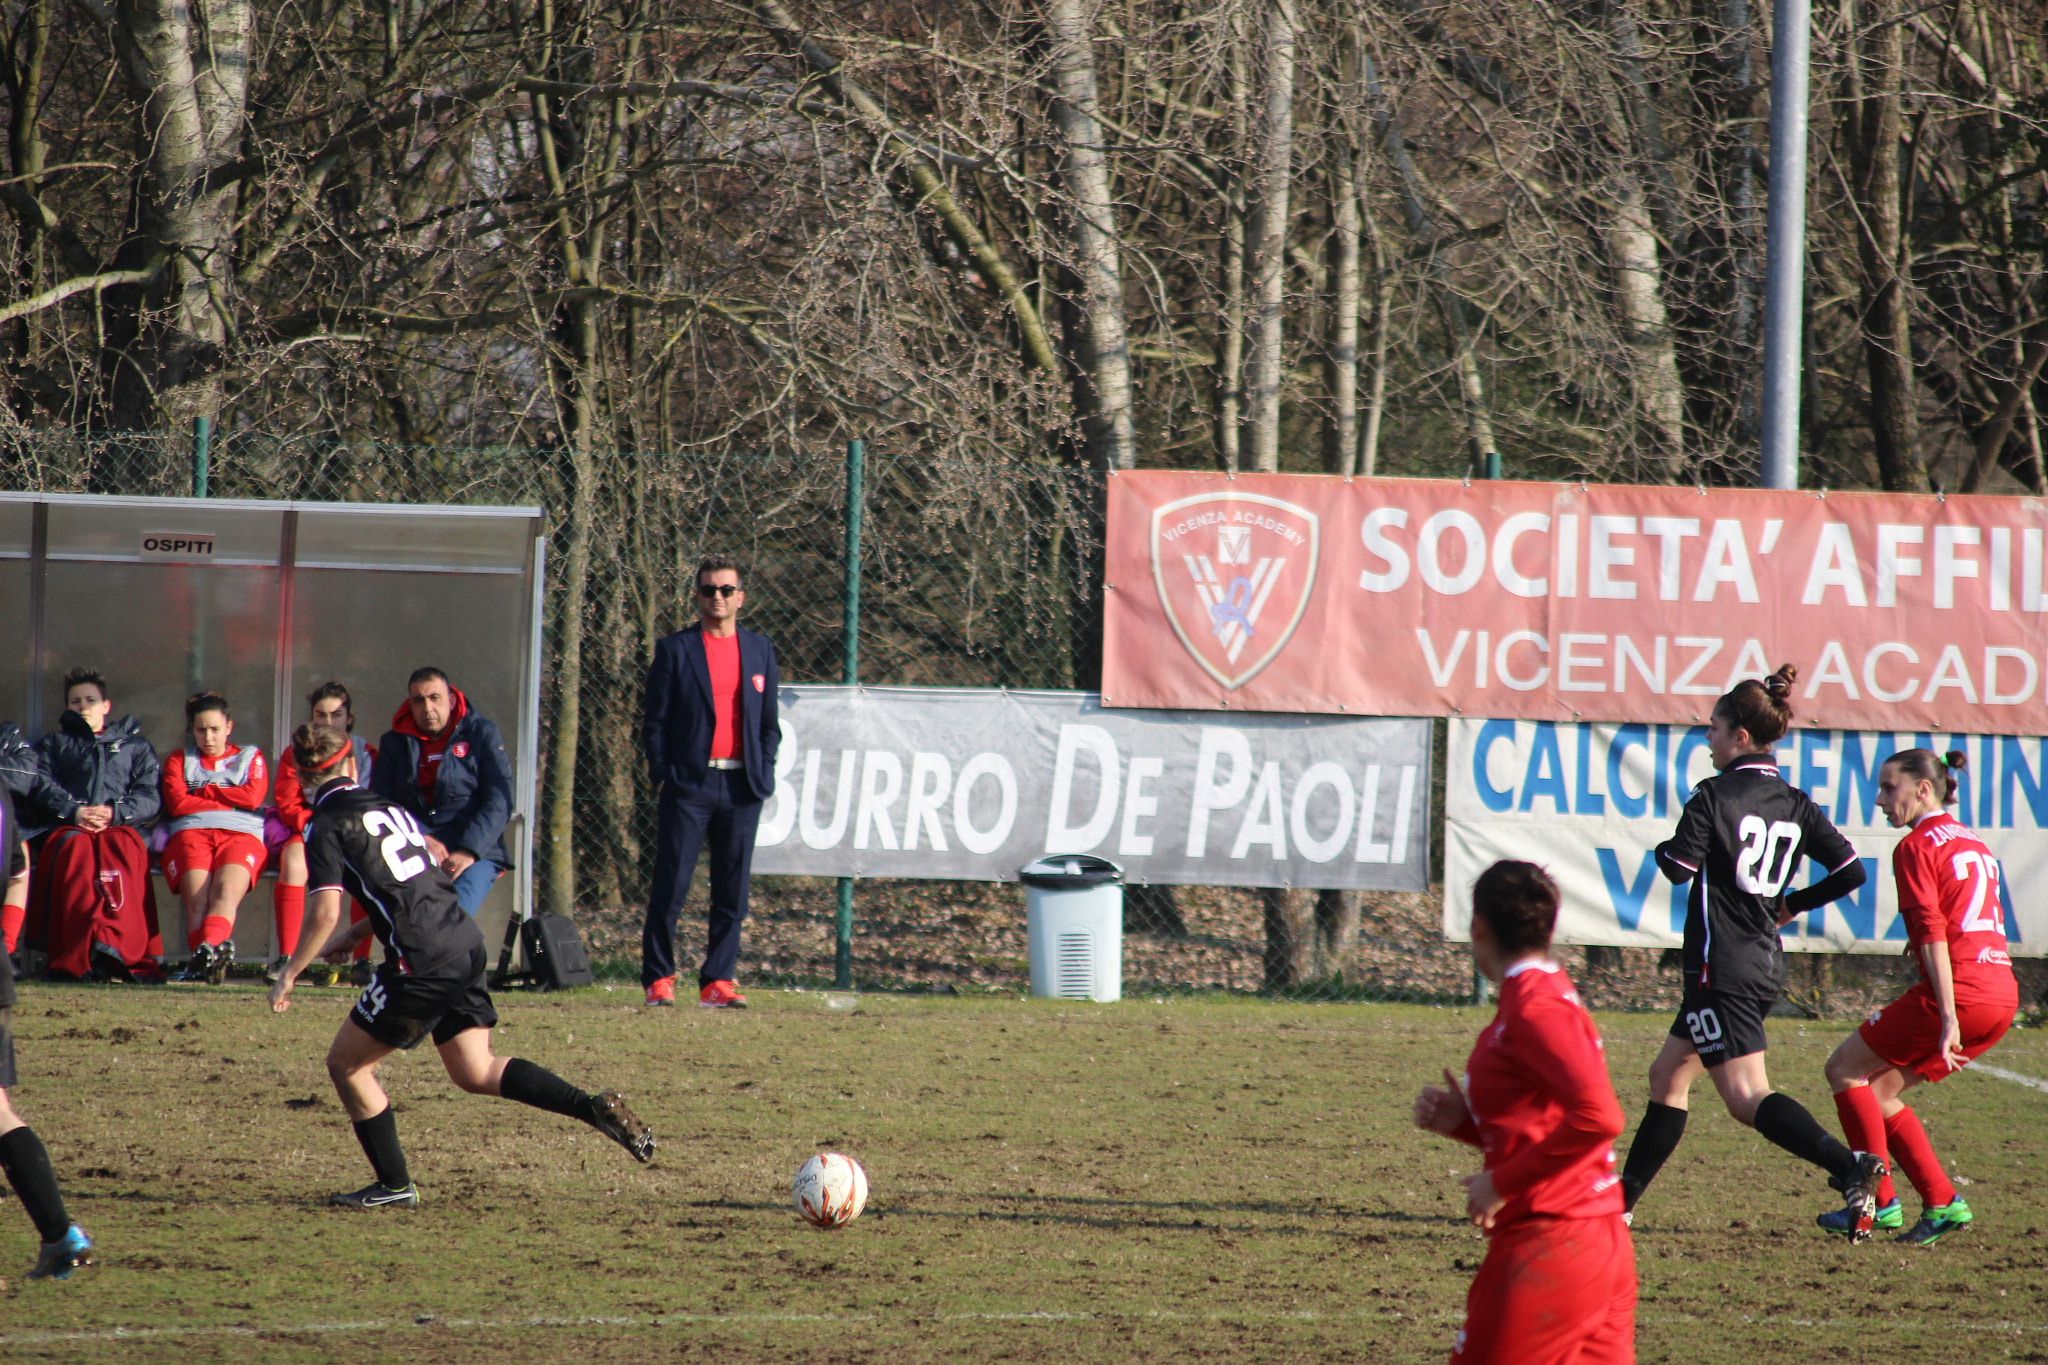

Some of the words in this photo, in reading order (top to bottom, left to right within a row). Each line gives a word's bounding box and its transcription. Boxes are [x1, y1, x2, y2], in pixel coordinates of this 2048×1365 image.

[143, 538, 213, 554] OSPITI
[1162, 511, 1226, 542] VICENZA
[1233, 511, 1306, 547] ACADEMY
[1359, 507, 1783, 603] SOCIETA'
[1415, 628, 1773, 696] VICENZA
[1185, 727, 1417, 864] PAOLI
[362, 806, 438, 882] 24
[1736, 813, 1802, 898] 20
[1952, 850, 2007, 937] 23
[1686, 1008, 1723, 1044] 20
